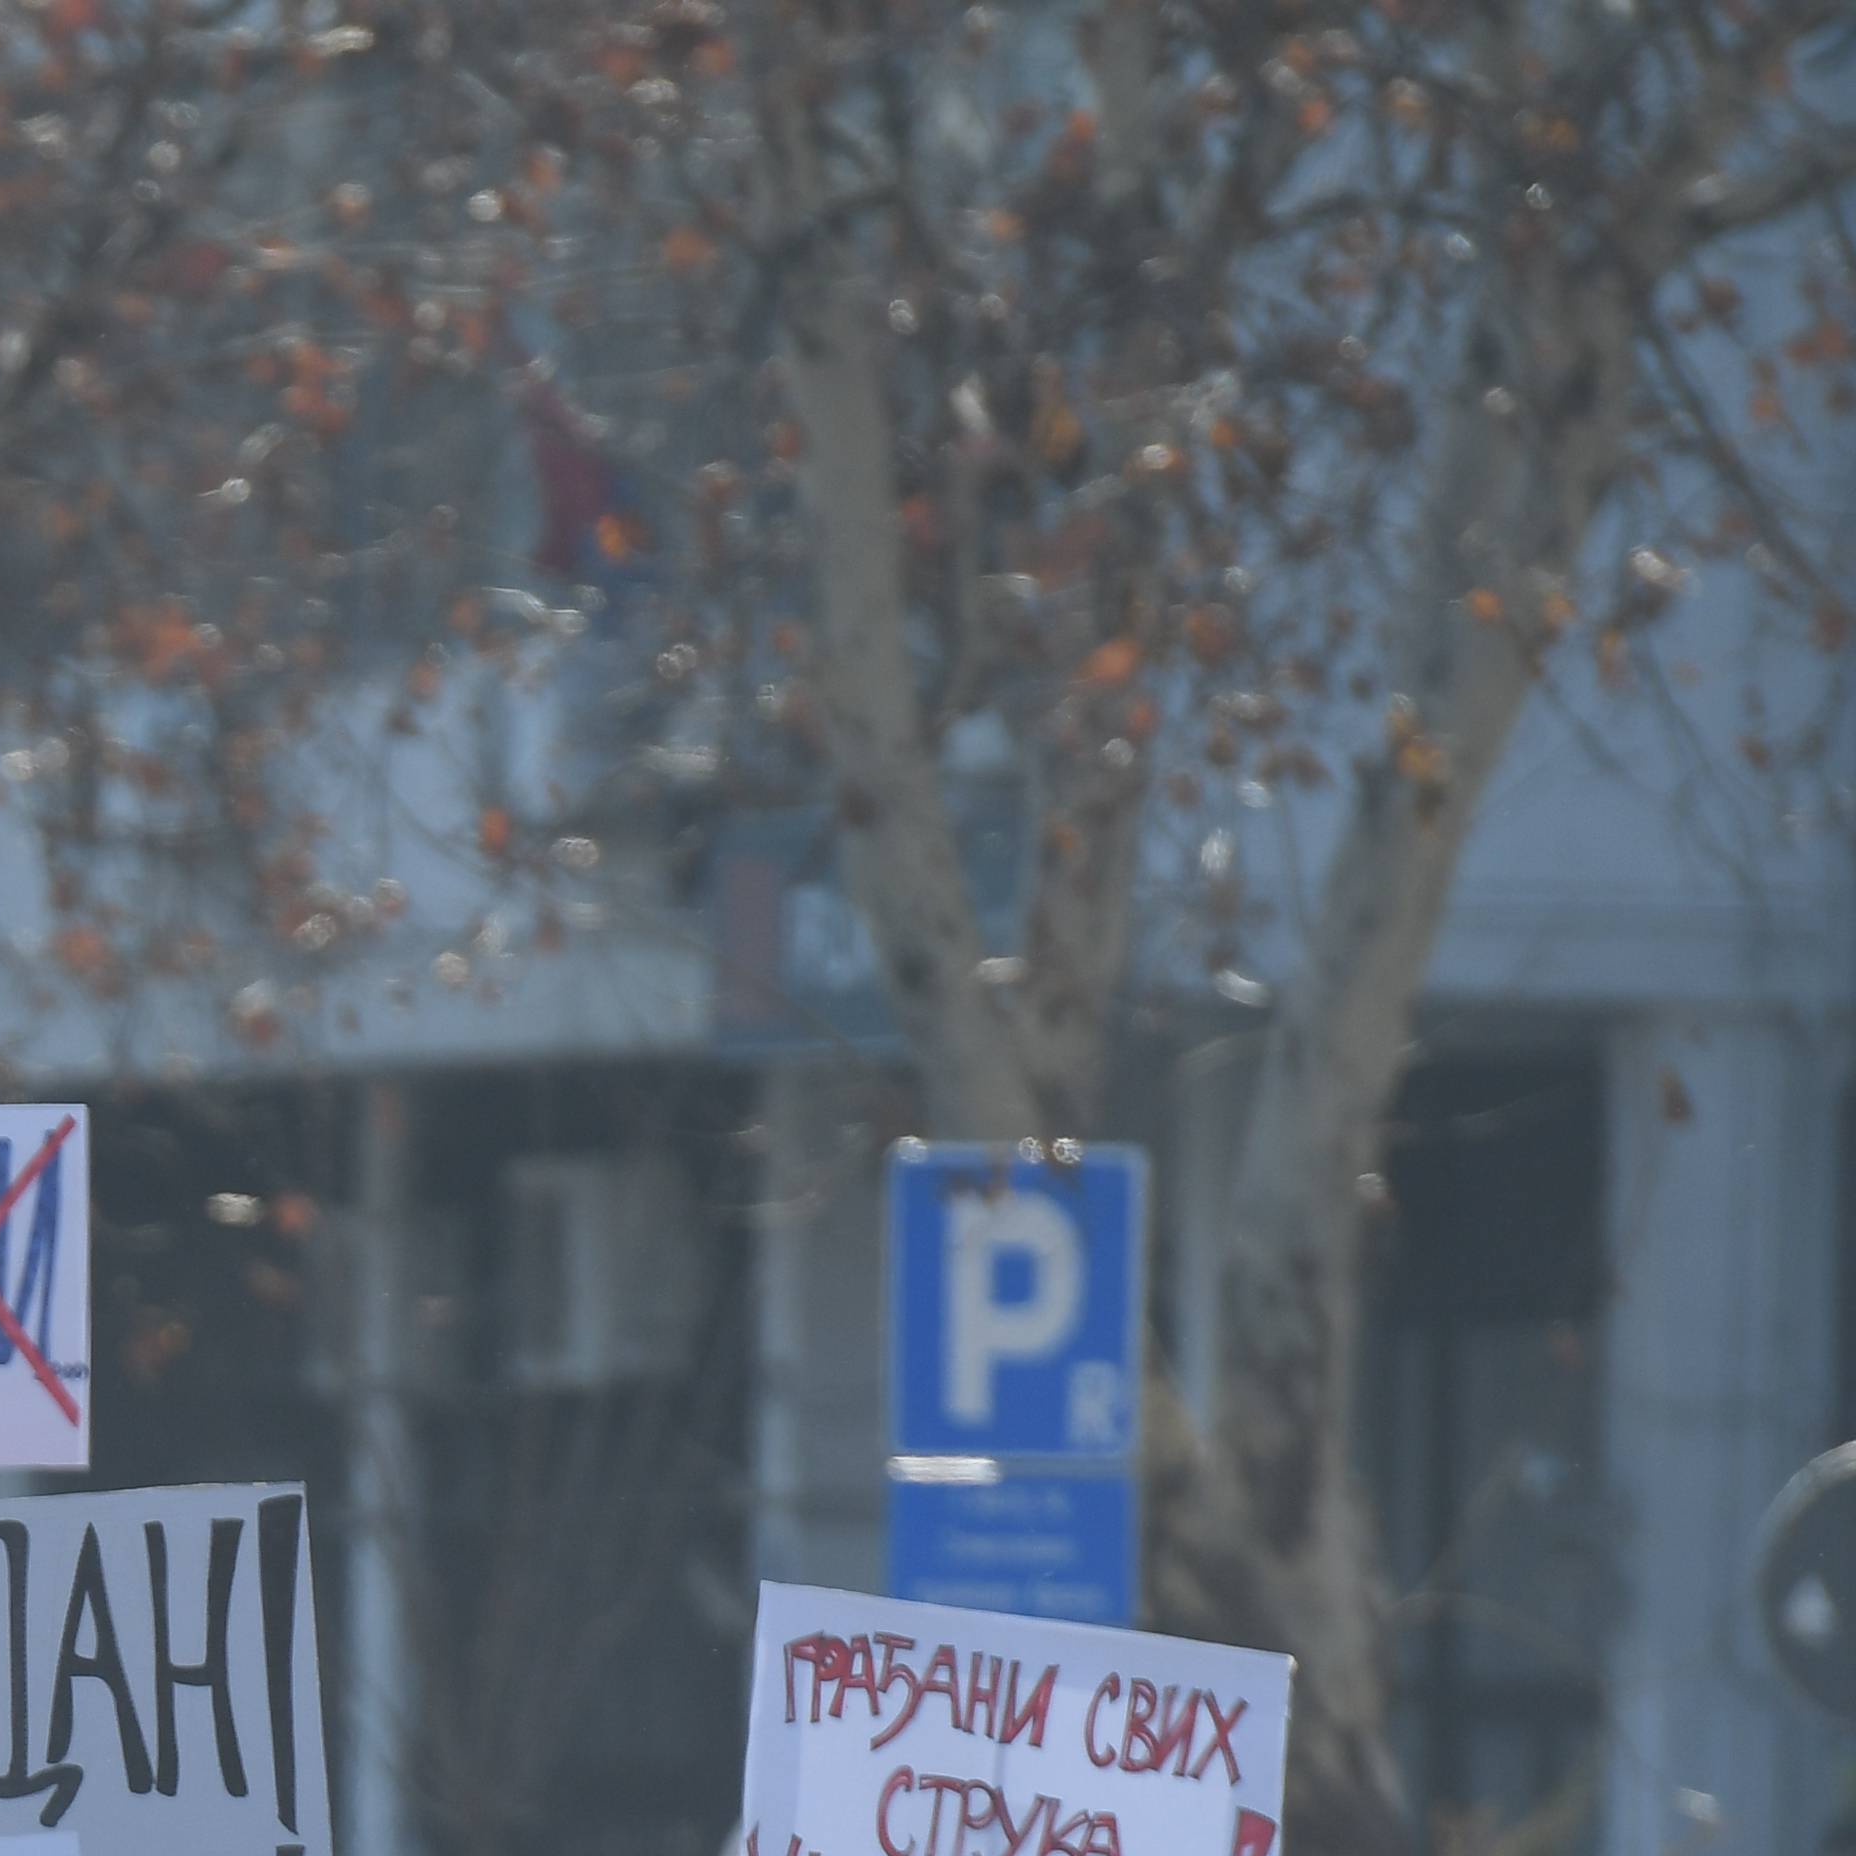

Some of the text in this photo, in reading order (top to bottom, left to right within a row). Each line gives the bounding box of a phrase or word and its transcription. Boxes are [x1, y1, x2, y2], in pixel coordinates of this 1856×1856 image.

[943, 1186, 1082, 1430] P
[784, 1630, 1249, 1785] ГРАЂАНИ СВИХ
